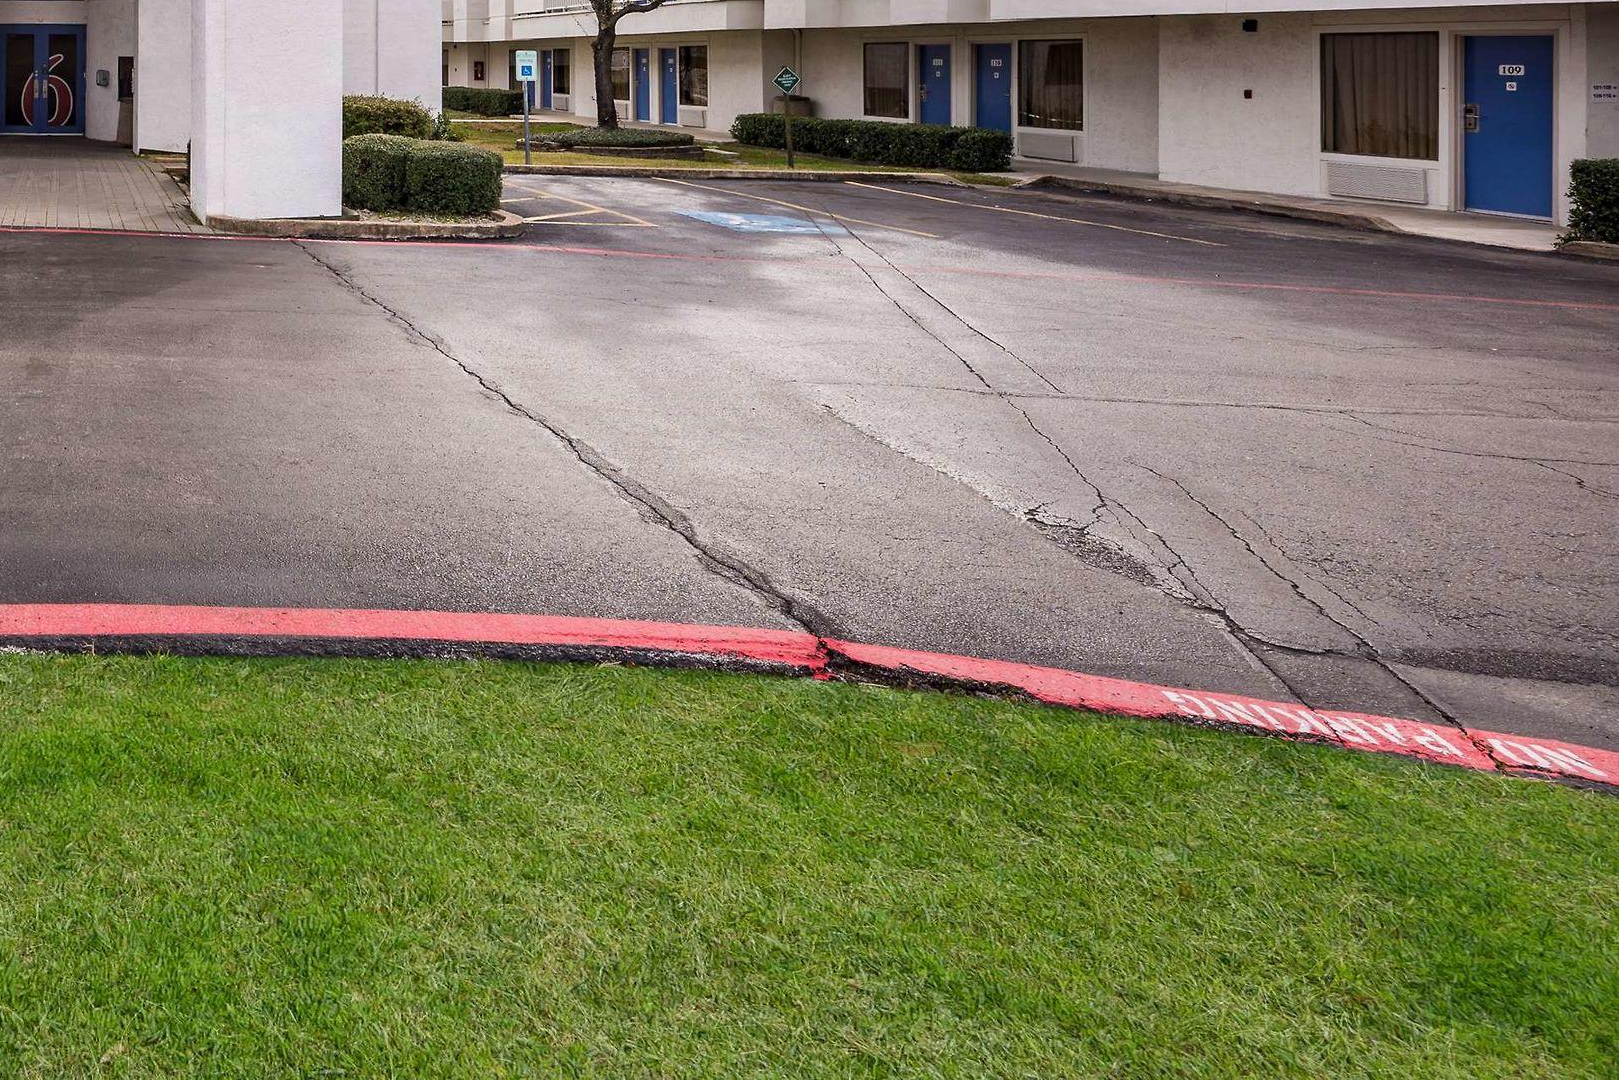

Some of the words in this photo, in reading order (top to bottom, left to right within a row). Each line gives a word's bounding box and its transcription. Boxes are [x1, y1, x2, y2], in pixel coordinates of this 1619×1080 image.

[21, 53, 74, 127] 6
[1502, 66, 1522, 74] 109
[1160, 690, 1466, 760] PARKING
[1487, 738, 1609, 777] NO
